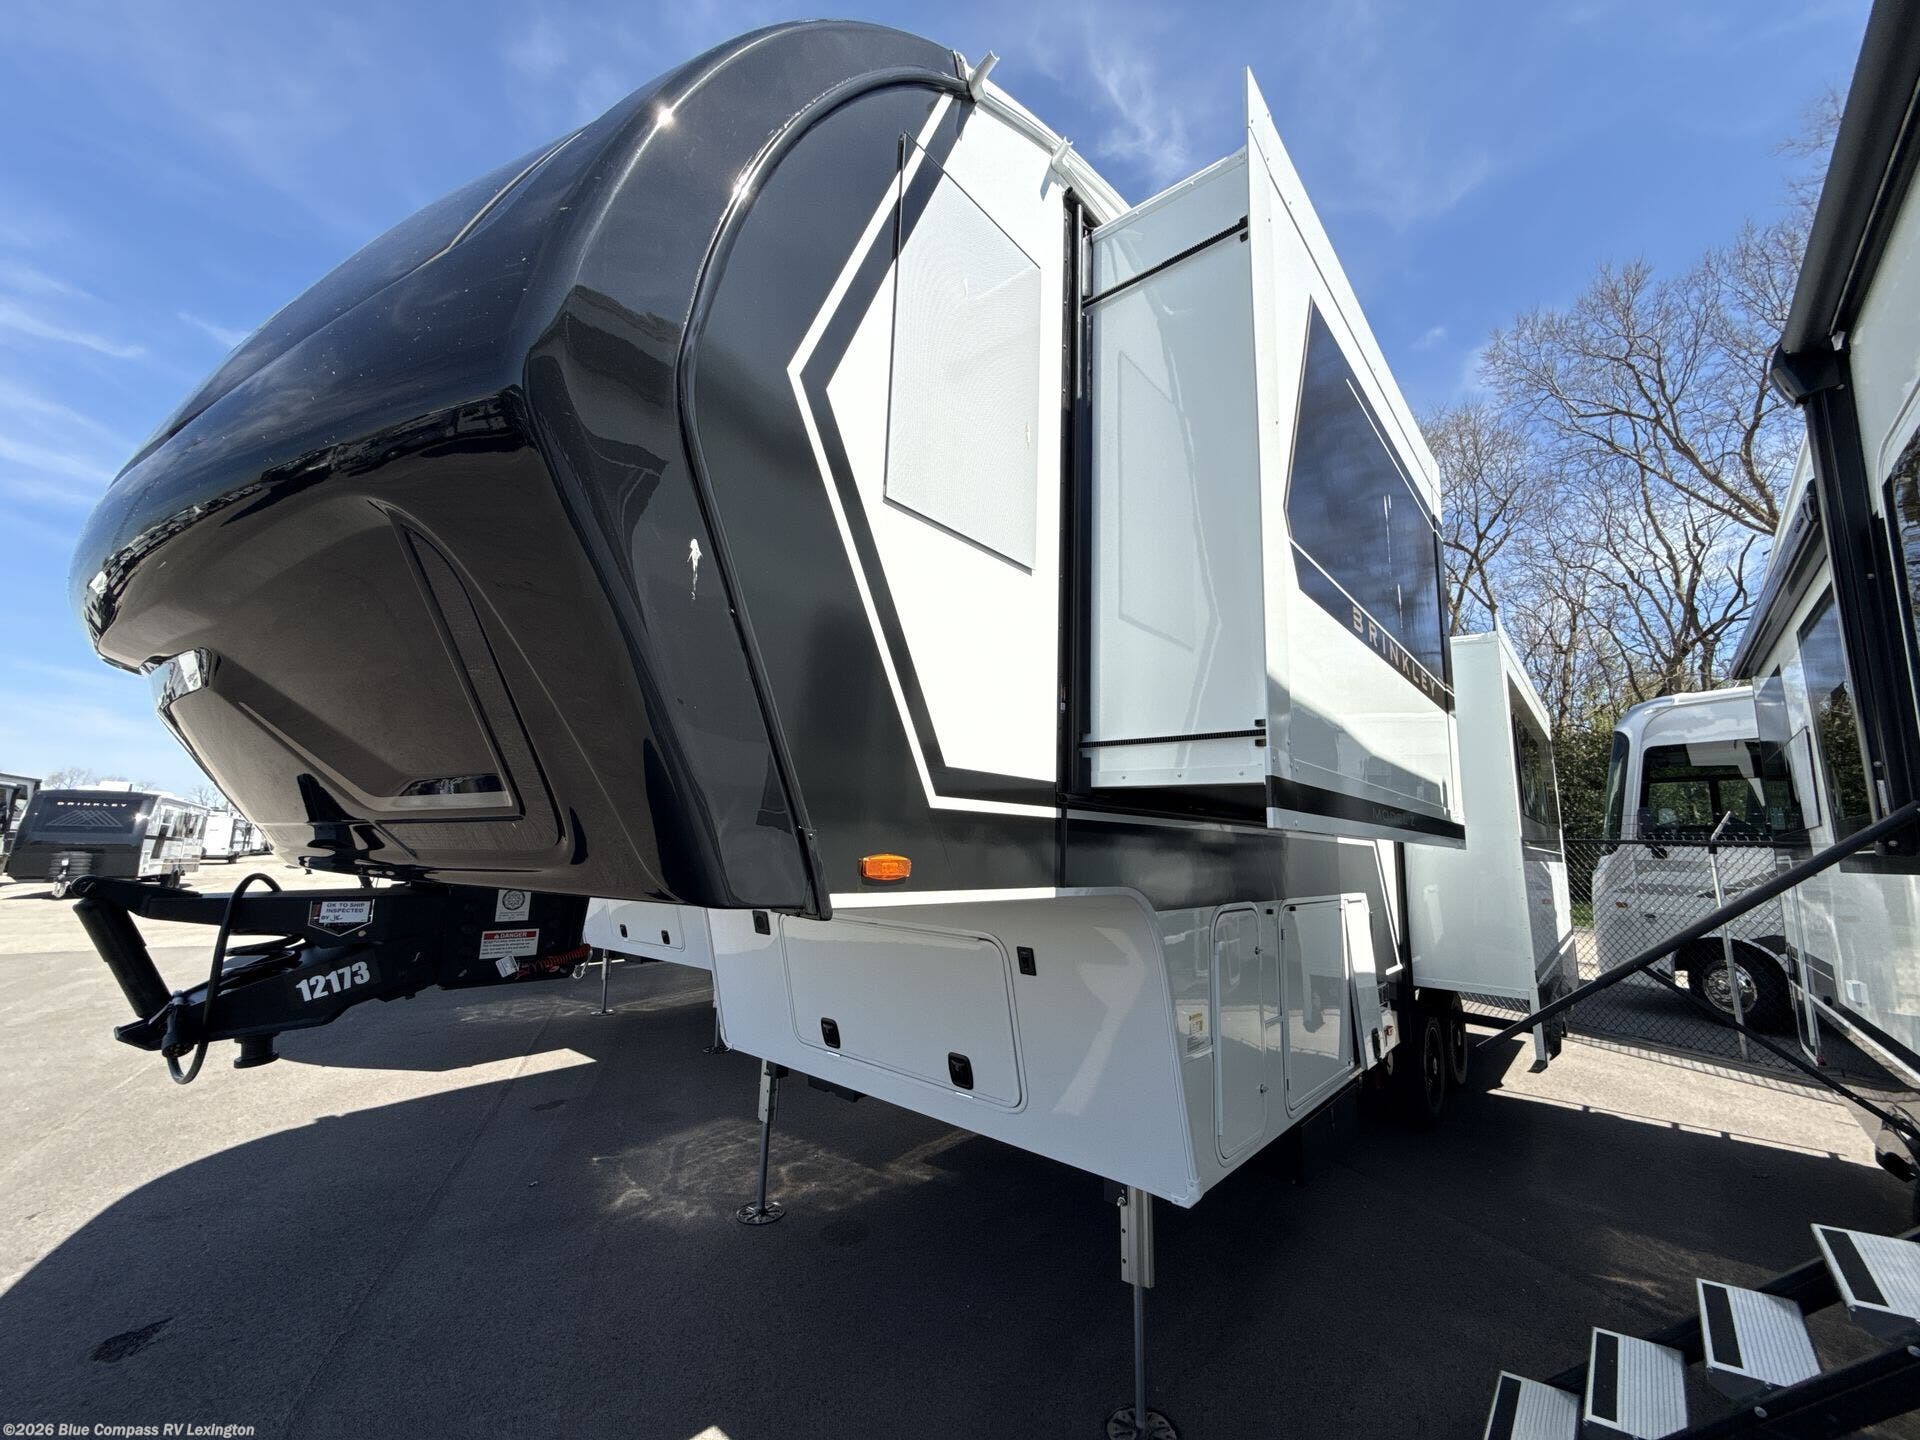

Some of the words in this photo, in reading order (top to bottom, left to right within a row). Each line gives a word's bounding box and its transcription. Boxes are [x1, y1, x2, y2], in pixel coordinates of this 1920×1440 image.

[1352, 605, 1436, 697] BRINKLEY
[500, 931, 528, 939] DANGER
[295, 961, 371, 1002] 12173
